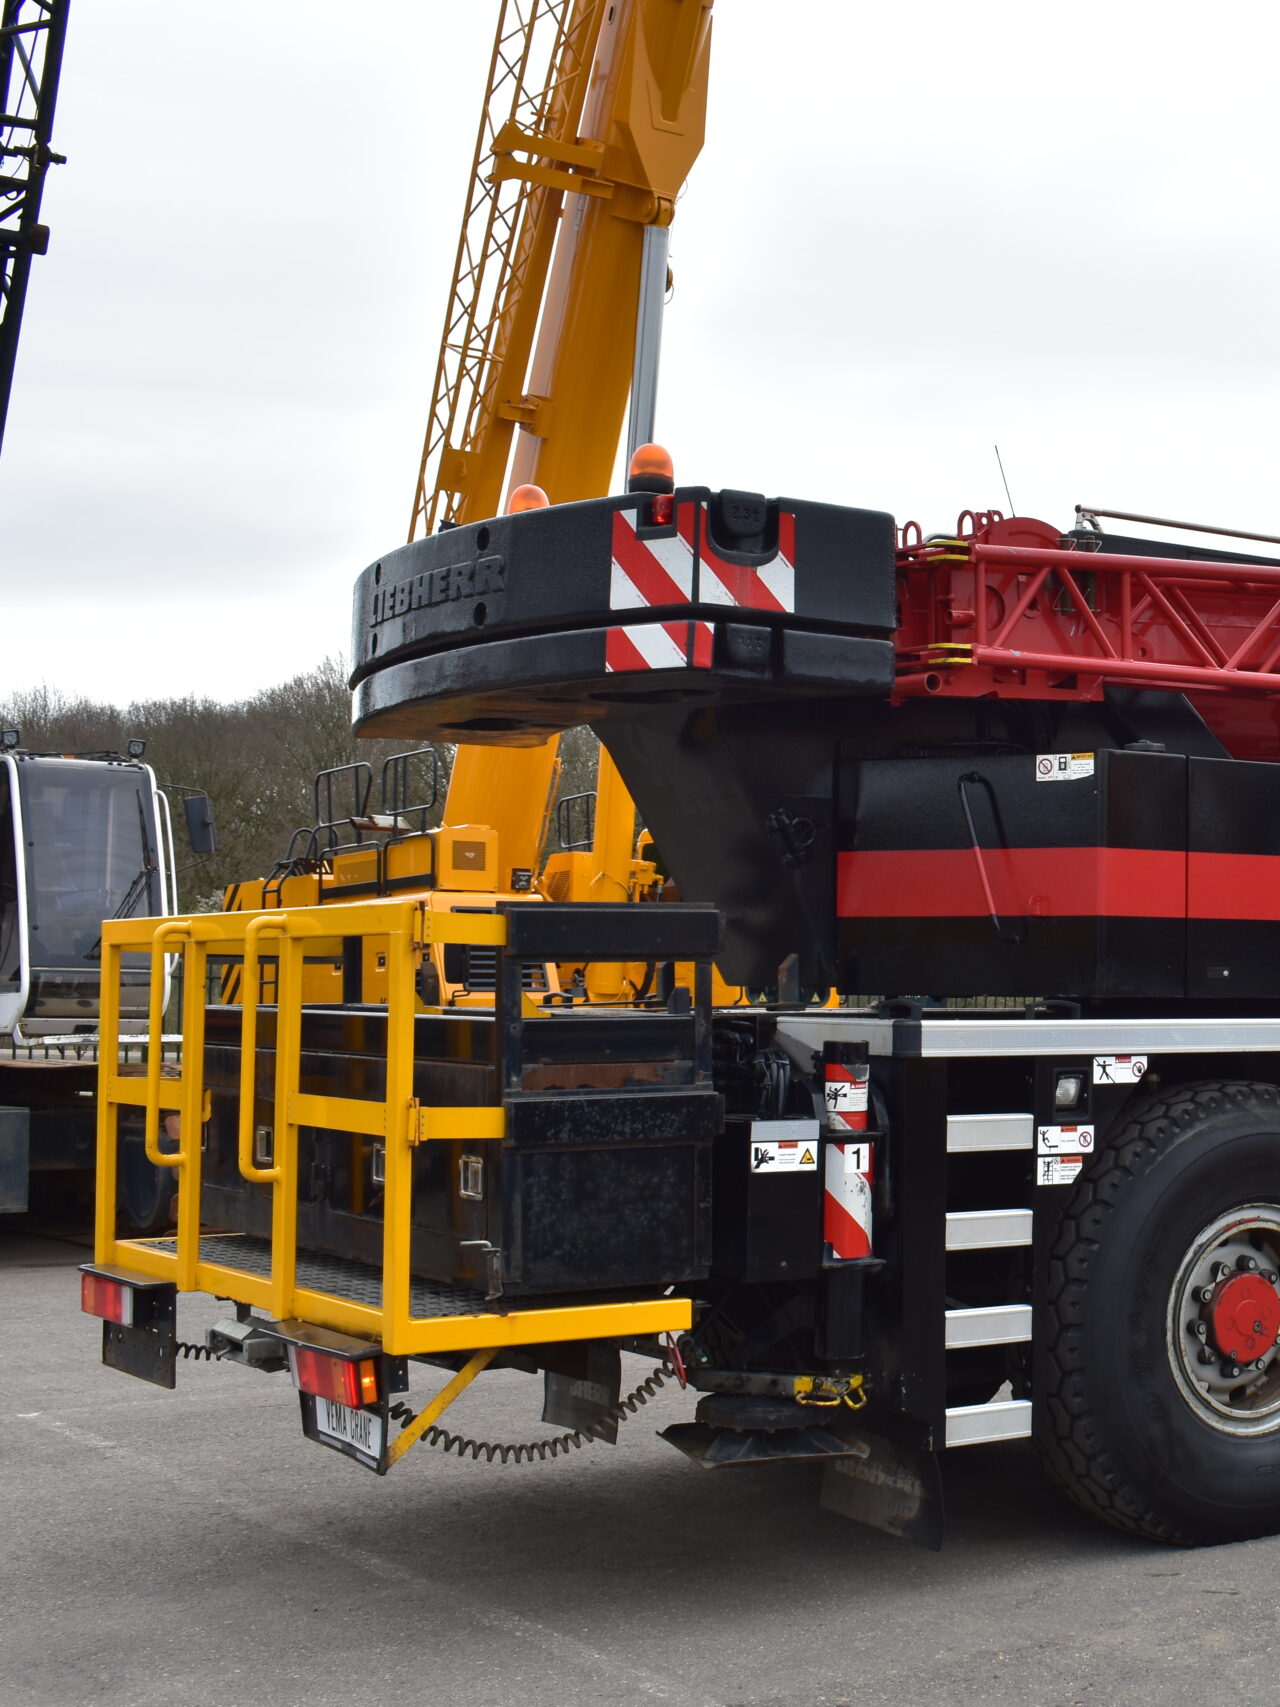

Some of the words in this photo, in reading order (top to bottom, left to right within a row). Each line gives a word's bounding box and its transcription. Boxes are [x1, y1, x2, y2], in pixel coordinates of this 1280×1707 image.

[370, 554, 505, 629] LIEBHERR
[852, 1147, 861, 1170] 1
[325, 1398, 348, 1437] VEMA
[350, 1408, 372, 1450] CRANE
